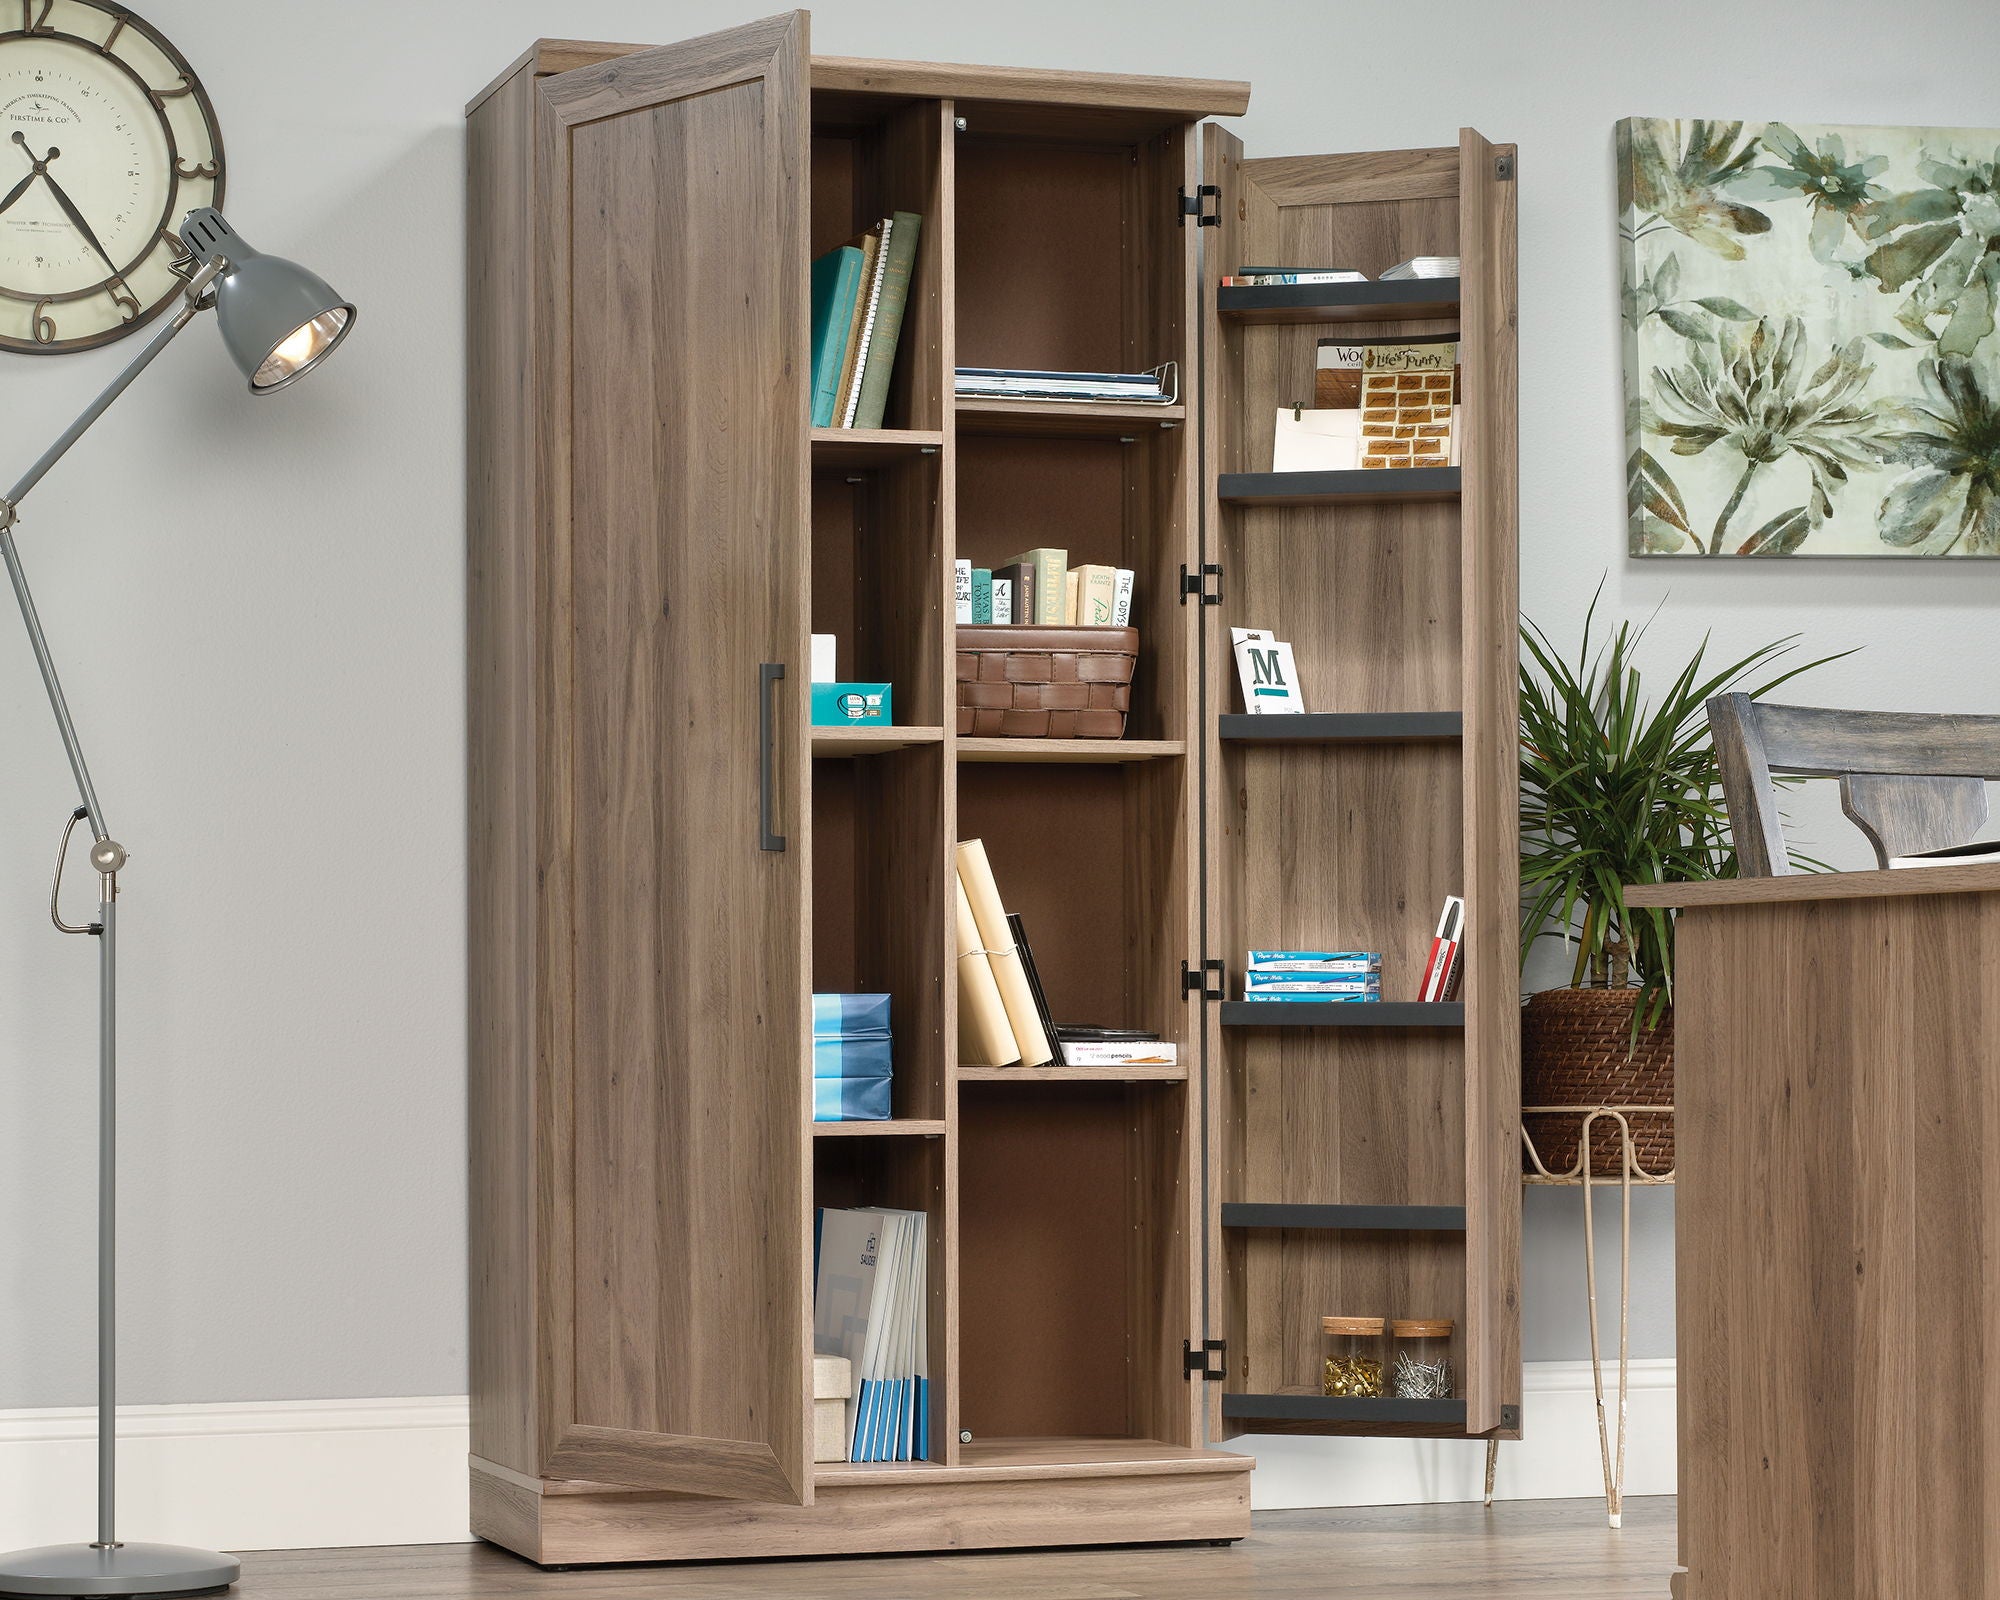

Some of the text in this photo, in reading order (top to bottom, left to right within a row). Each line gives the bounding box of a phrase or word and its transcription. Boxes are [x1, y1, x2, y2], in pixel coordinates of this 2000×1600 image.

[102, 12, 130, 53] 1
[149, 71, 195, 110] 2
[174, 156, 222, 179] 3
[104, 276, 140, 324] 5
[32, 296, 57, 345] 6
[955, 567, 966, 576] HE
[1119, 576, 1131, 595] THE
[1247, 648, 1287, 686] M
